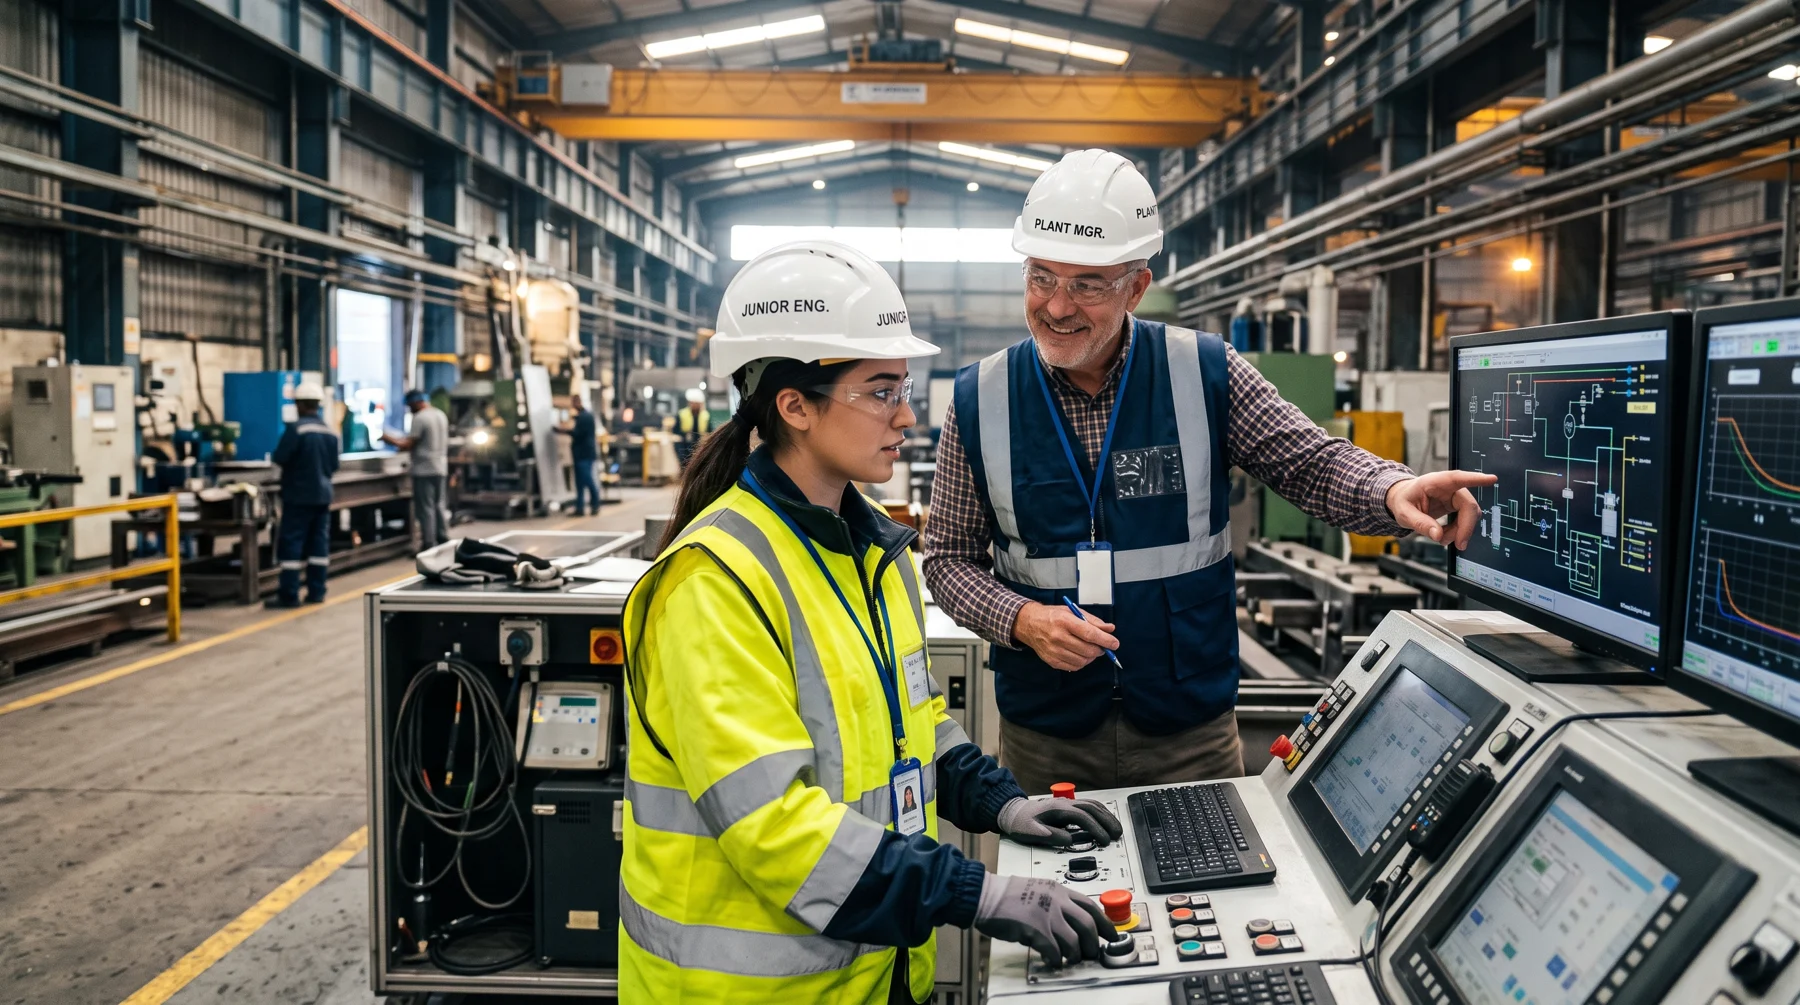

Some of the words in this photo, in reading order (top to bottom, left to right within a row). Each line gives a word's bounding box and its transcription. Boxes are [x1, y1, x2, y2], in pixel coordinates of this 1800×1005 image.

[1034, 218, 1071, 234] PLANT
[1073, 224, 1105, 239] MGR.
[741, 300, 789, 317] JUNIOR
[794, 299, 830, 313] ENG.
